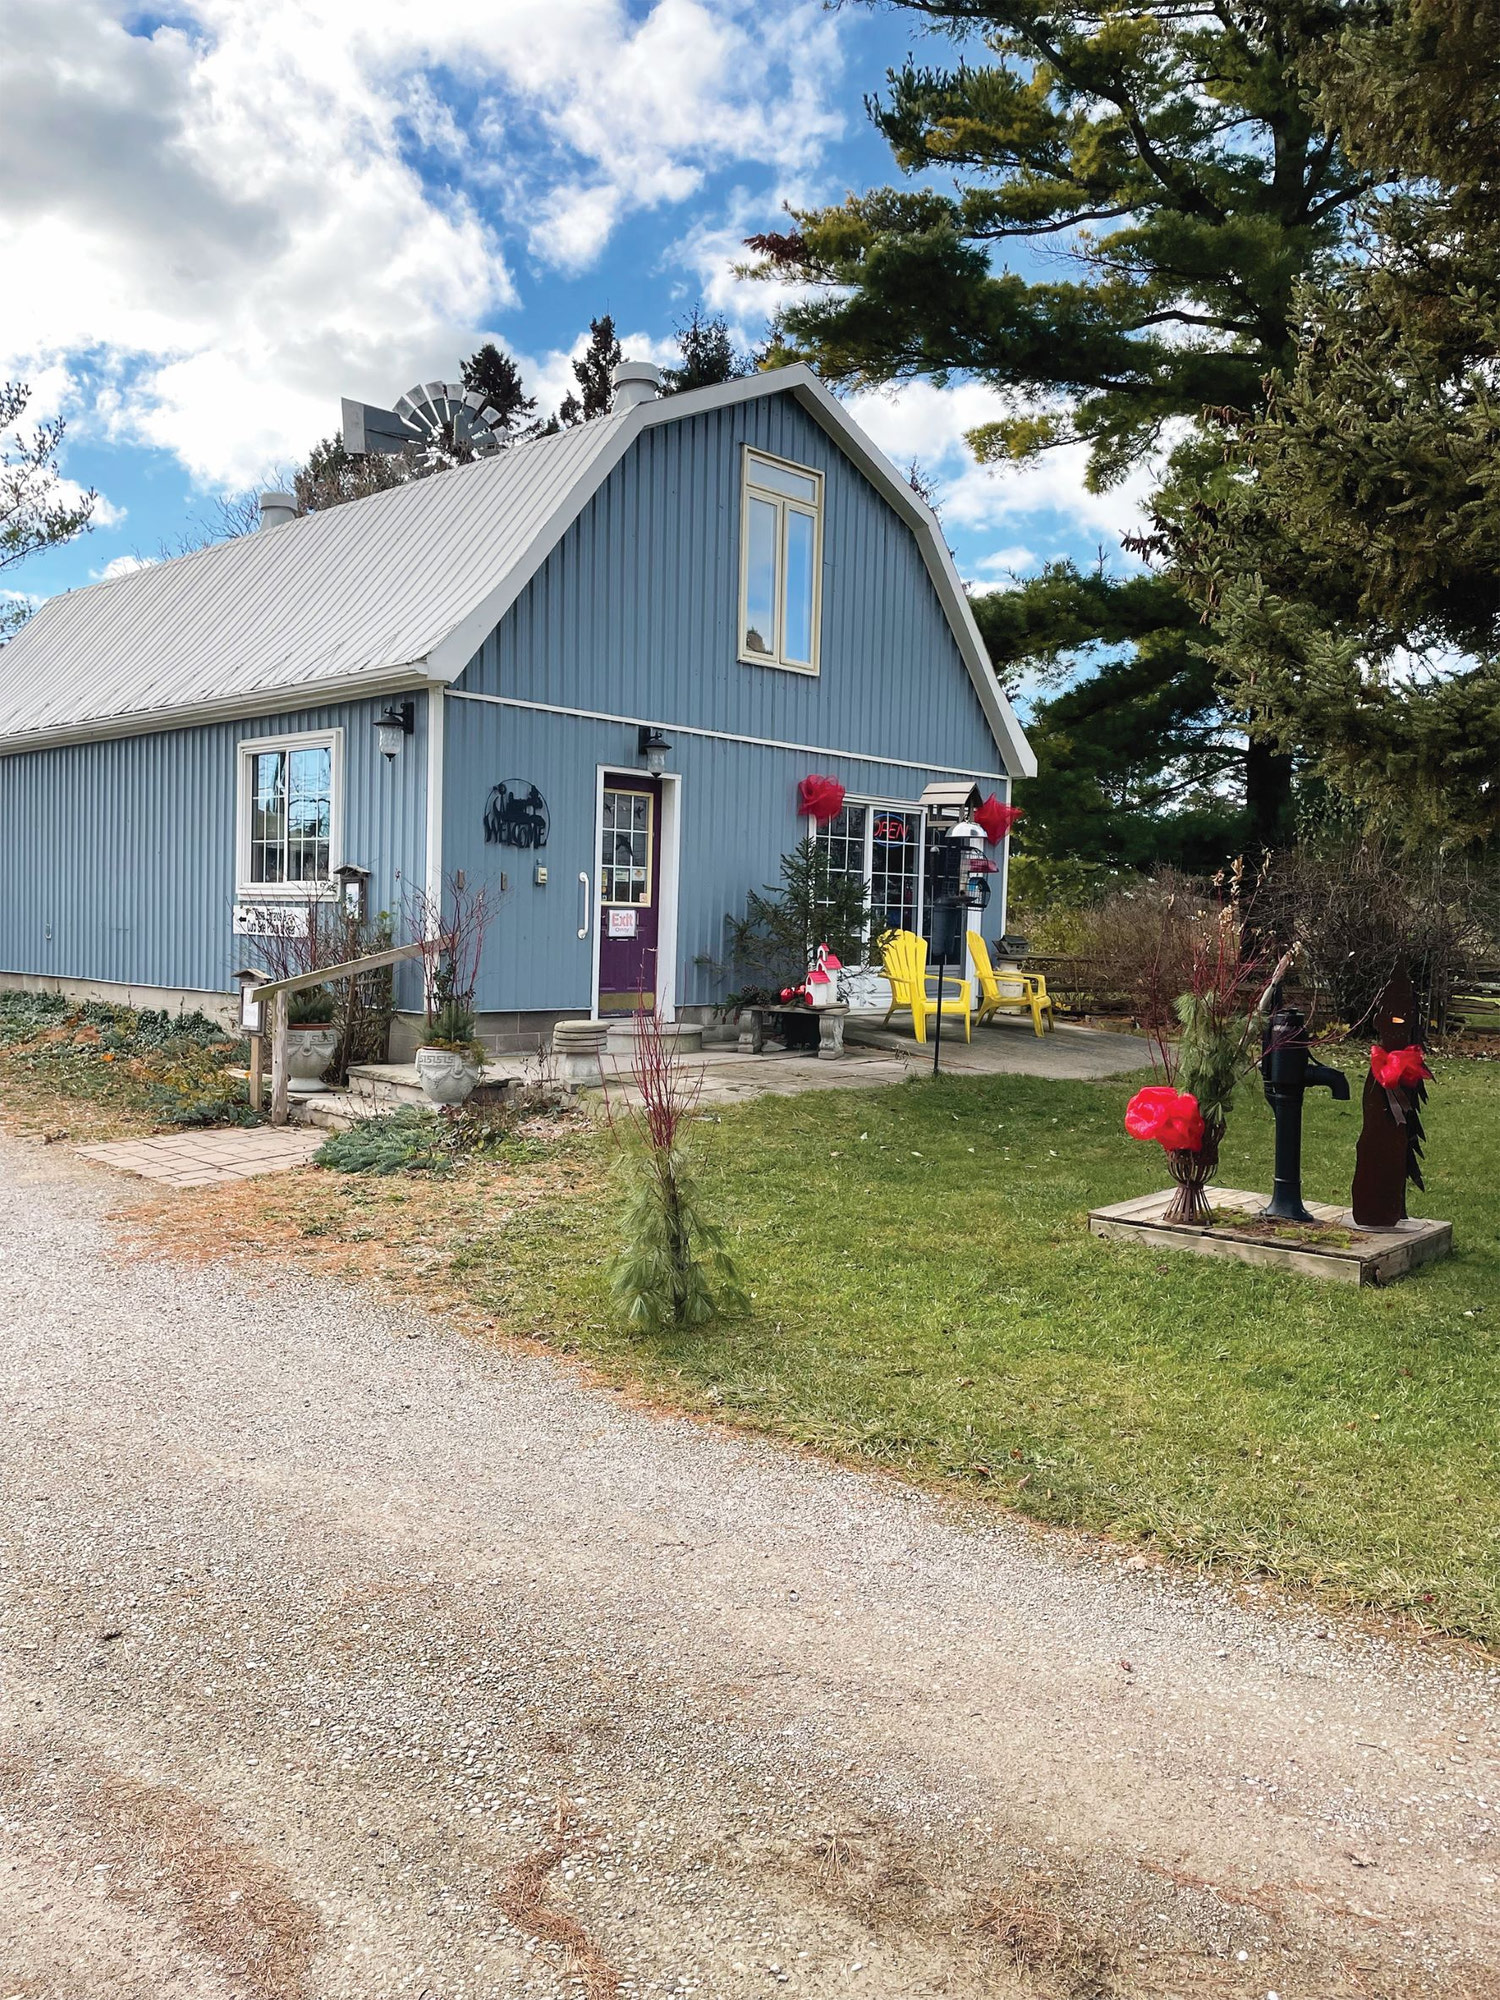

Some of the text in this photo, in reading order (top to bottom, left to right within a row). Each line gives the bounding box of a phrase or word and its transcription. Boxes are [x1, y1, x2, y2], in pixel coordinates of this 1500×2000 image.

[484, 811, 547, 849] WELCOME
[873, 820, 909, 839] OPEN
[611, 912, 633, 927] Exit
